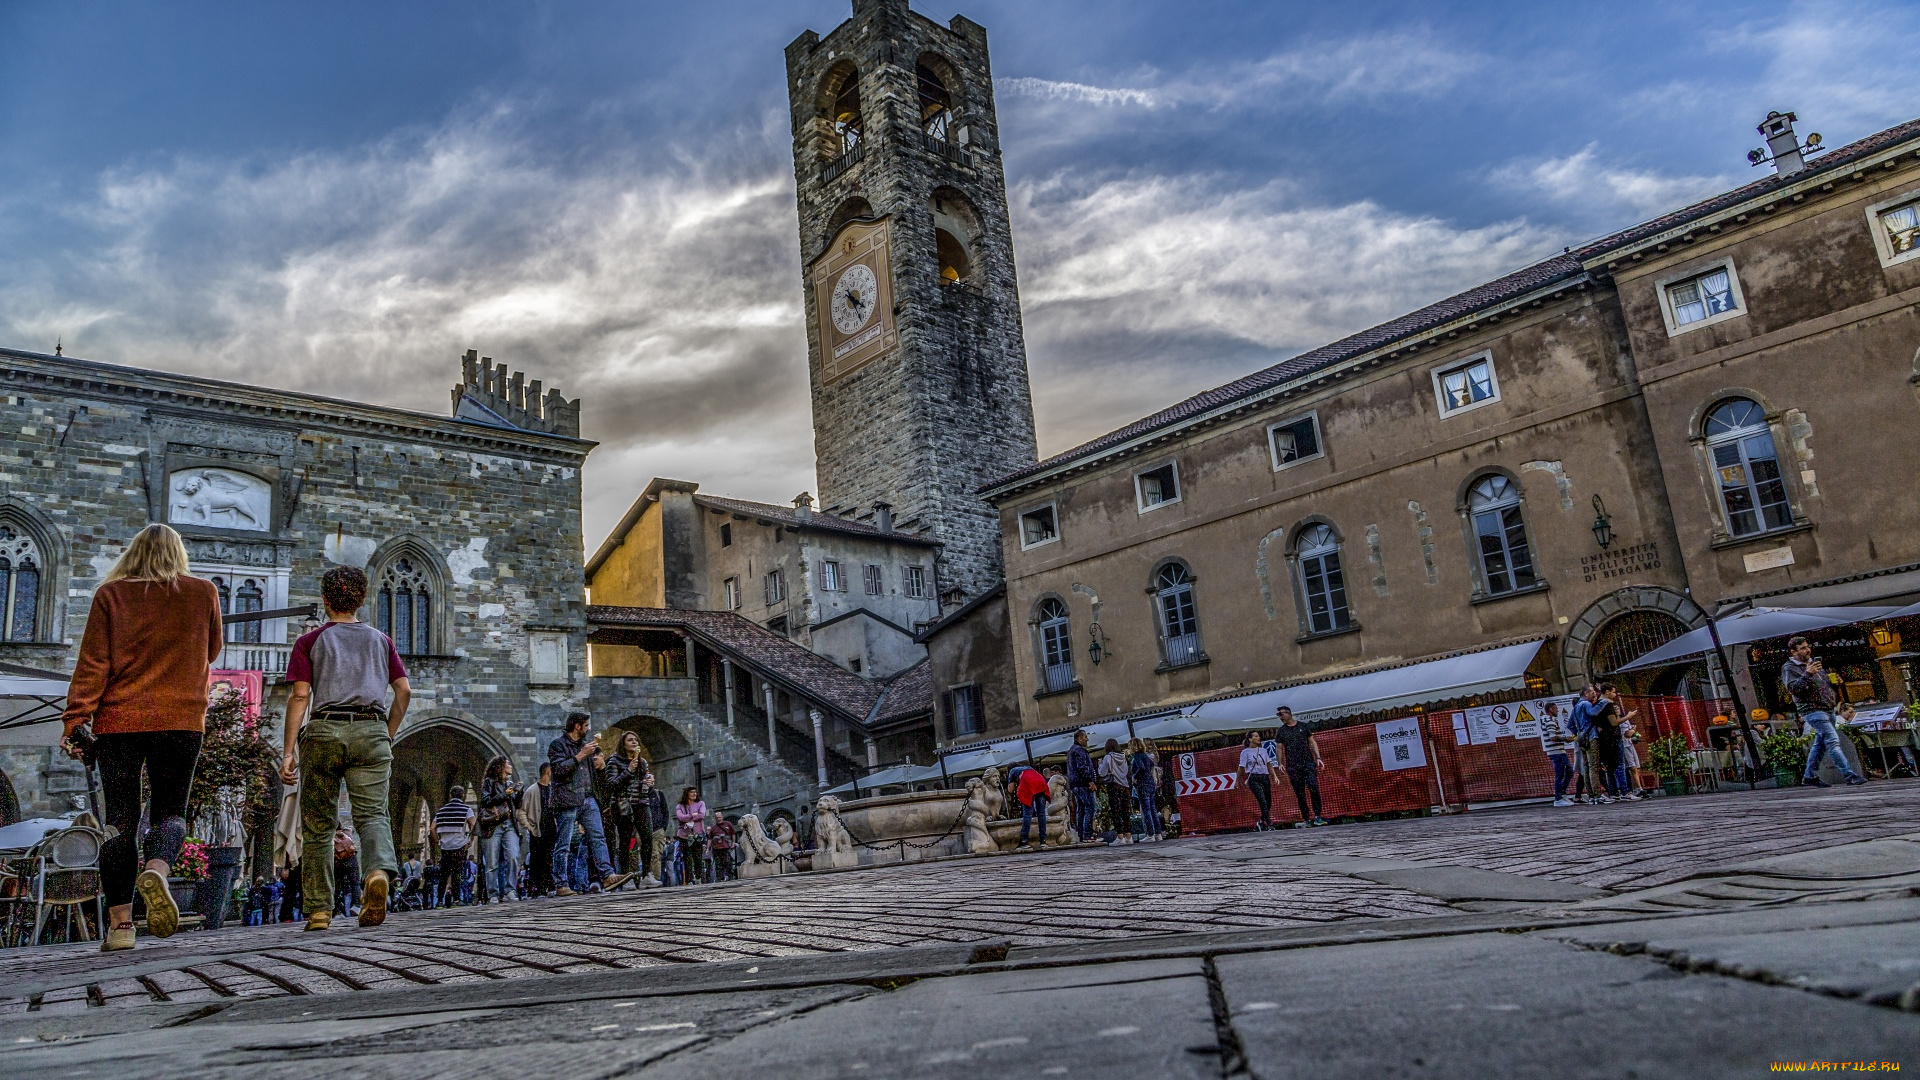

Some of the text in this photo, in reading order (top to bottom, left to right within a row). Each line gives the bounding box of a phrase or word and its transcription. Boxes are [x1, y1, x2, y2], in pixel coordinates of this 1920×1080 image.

[1582, 550, 1660, 574] DEGLI STUDI
[1584, 560, 1661, 583] DI BERGAMO
